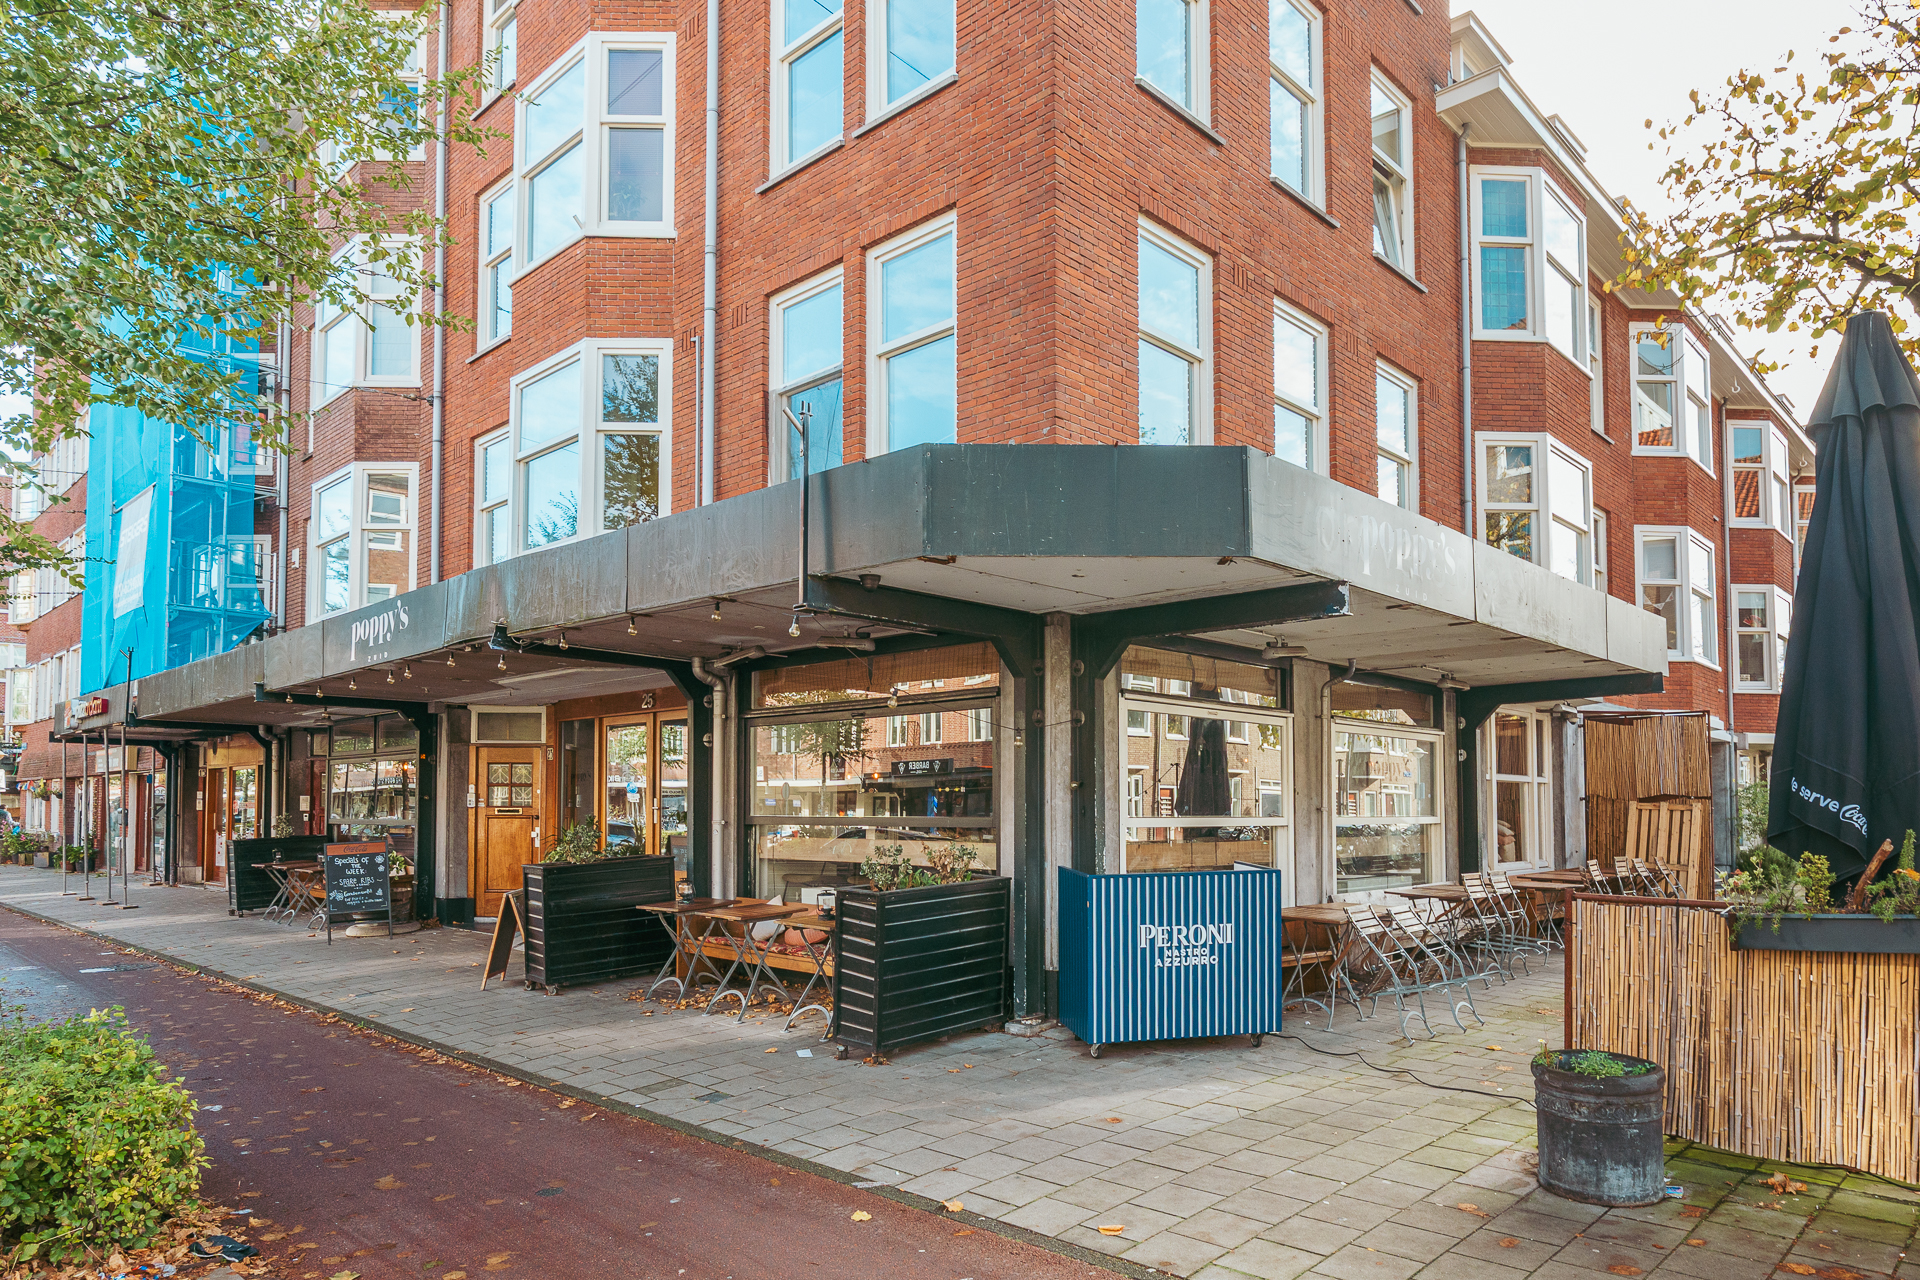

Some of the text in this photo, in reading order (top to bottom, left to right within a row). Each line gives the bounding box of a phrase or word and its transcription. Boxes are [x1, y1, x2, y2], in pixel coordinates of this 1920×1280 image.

[1395, 584, 1428, 601] ZUID
[350, 599, 409, 661] poppy's
[642, 693, 653, 709] 25
[1799, 785, 1840, 812] serve
[1139, 923, 1232, 948] PERONI
[1165, 947, 1208, 957] NASTRO
[1154, 955, 1219, 968] AZZURRO
